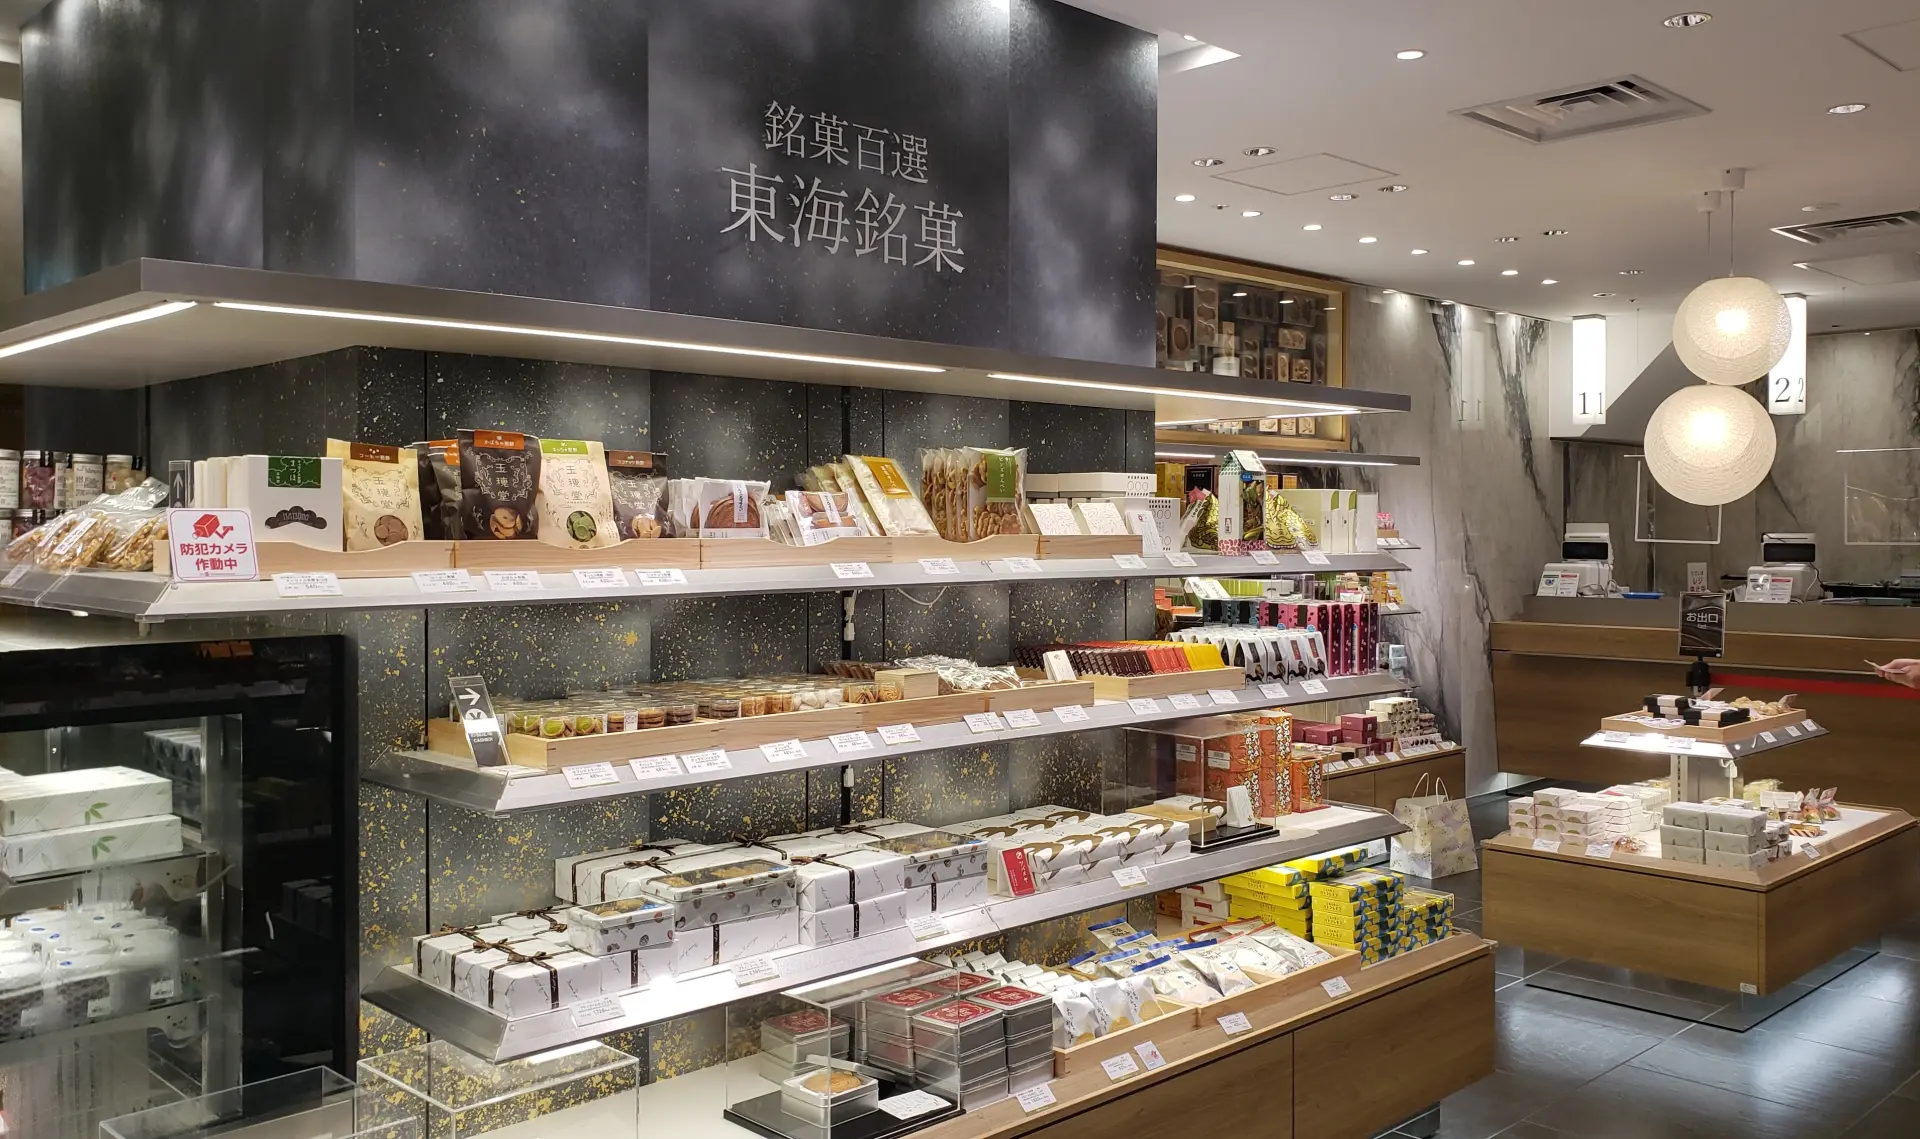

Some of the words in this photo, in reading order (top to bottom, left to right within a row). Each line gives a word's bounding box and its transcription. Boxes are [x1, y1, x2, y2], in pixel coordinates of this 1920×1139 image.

[764, 100, 929, 184] 銘菓百選
[720, 163, 965, 274] 東海銘菓
[1775, 378, 1791, 403] 2
[1579, 392, 1590, 415] 1
[495, 463, 510, 501] 玉穂堂
[565, 465, 584, 501] 玉穂堂
[180, 543, 248, 555] 防犯カメラ
[195, 558, 237, 570] 作動中
[1686, 612, 1719, 624] お出口
